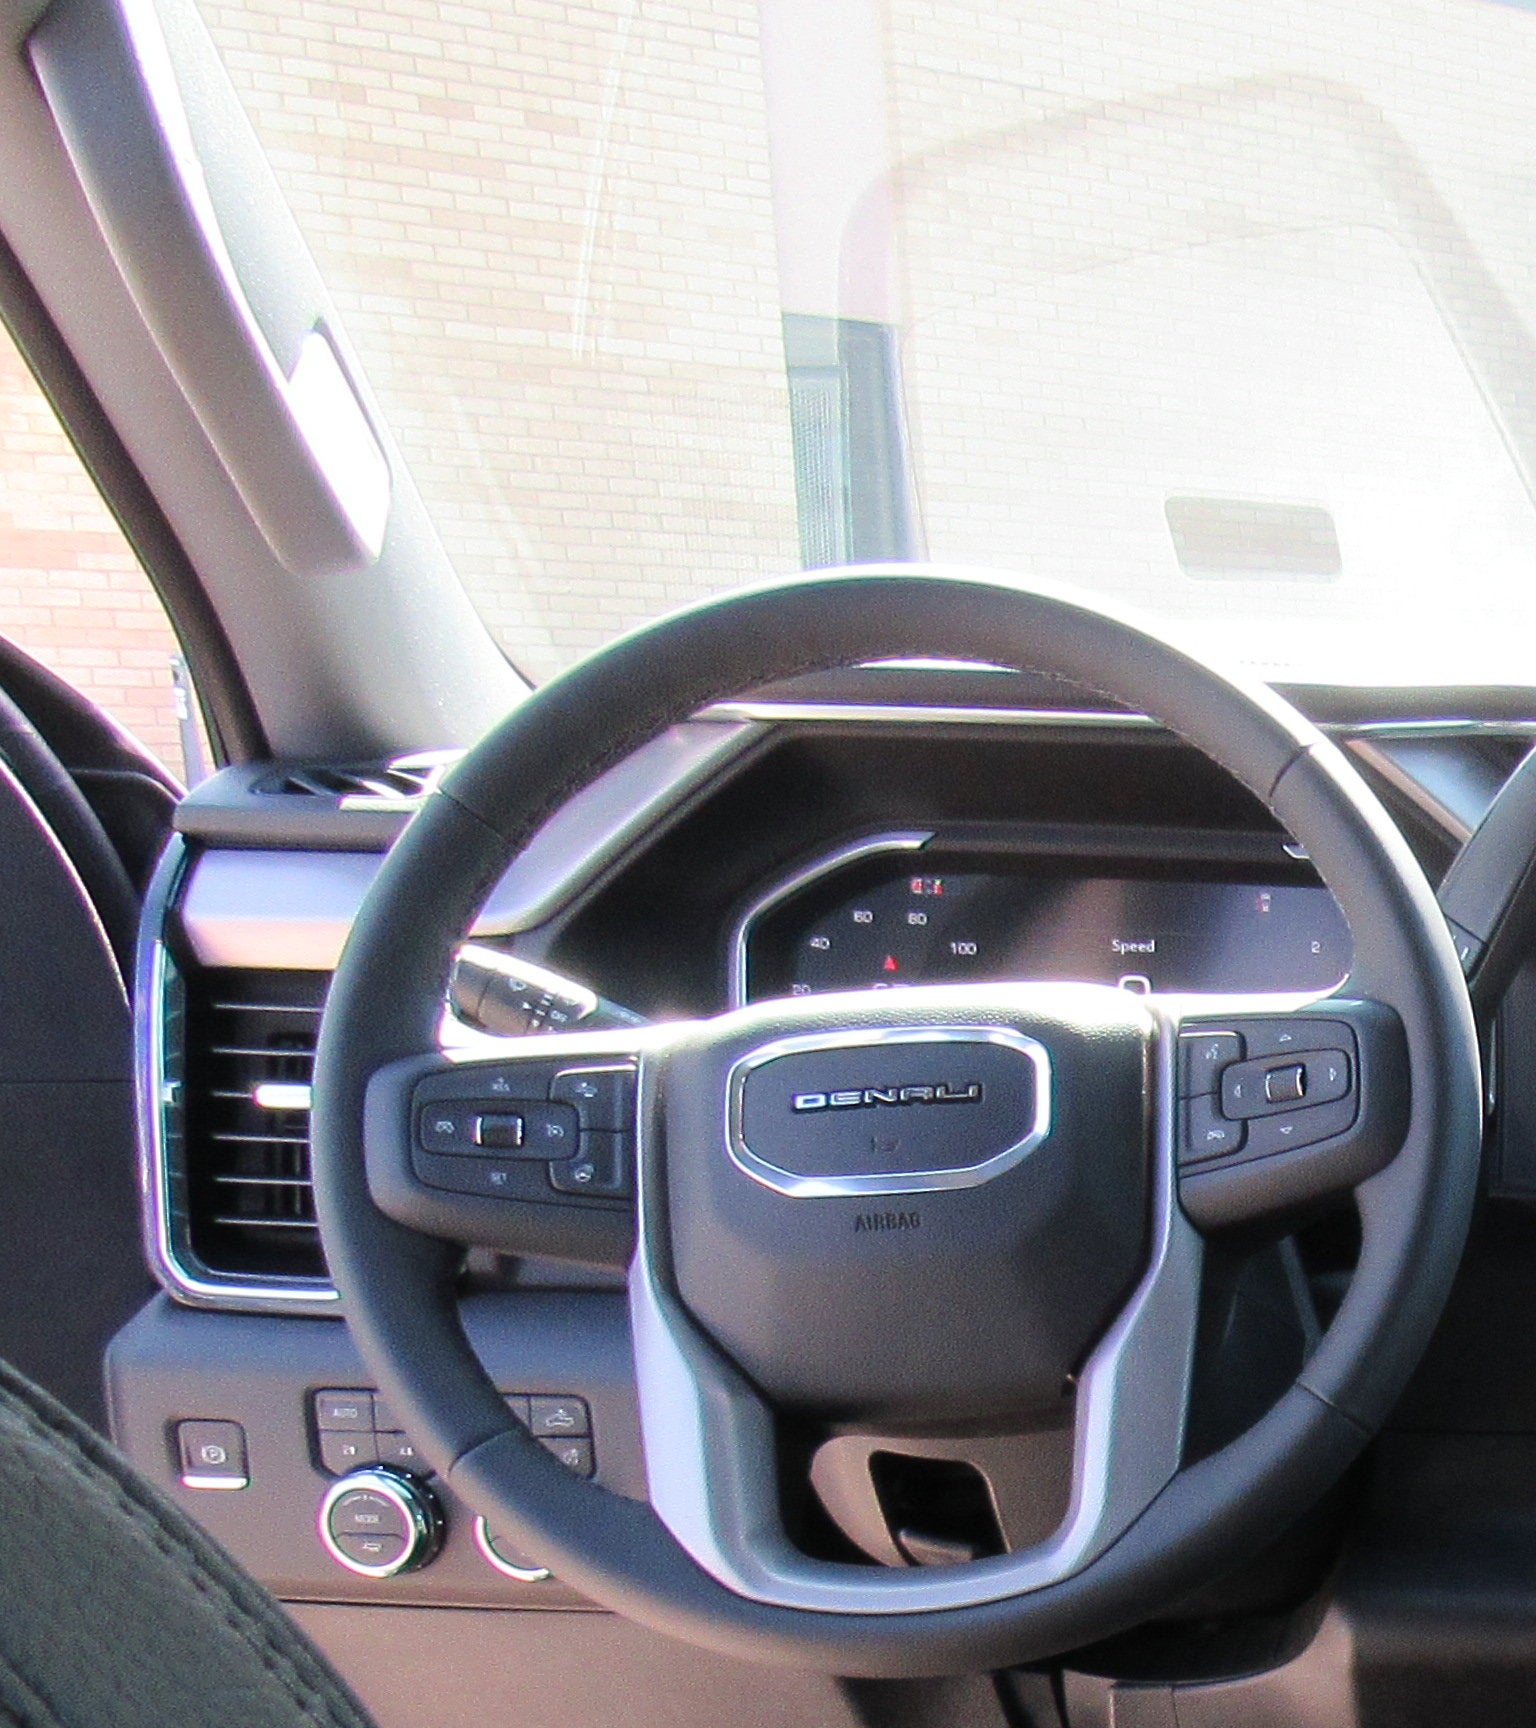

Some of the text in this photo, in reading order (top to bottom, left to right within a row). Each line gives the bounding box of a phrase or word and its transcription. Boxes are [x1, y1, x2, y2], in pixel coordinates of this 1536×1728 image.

[809, 937, 830, 950] 40
[950, 942, 978, 955] 100
[1111, 940, 1155, 955] Speed
[793, 1083, 980, 1110] DENALI
[854, 1211, 922, 1233] AIRBAG
